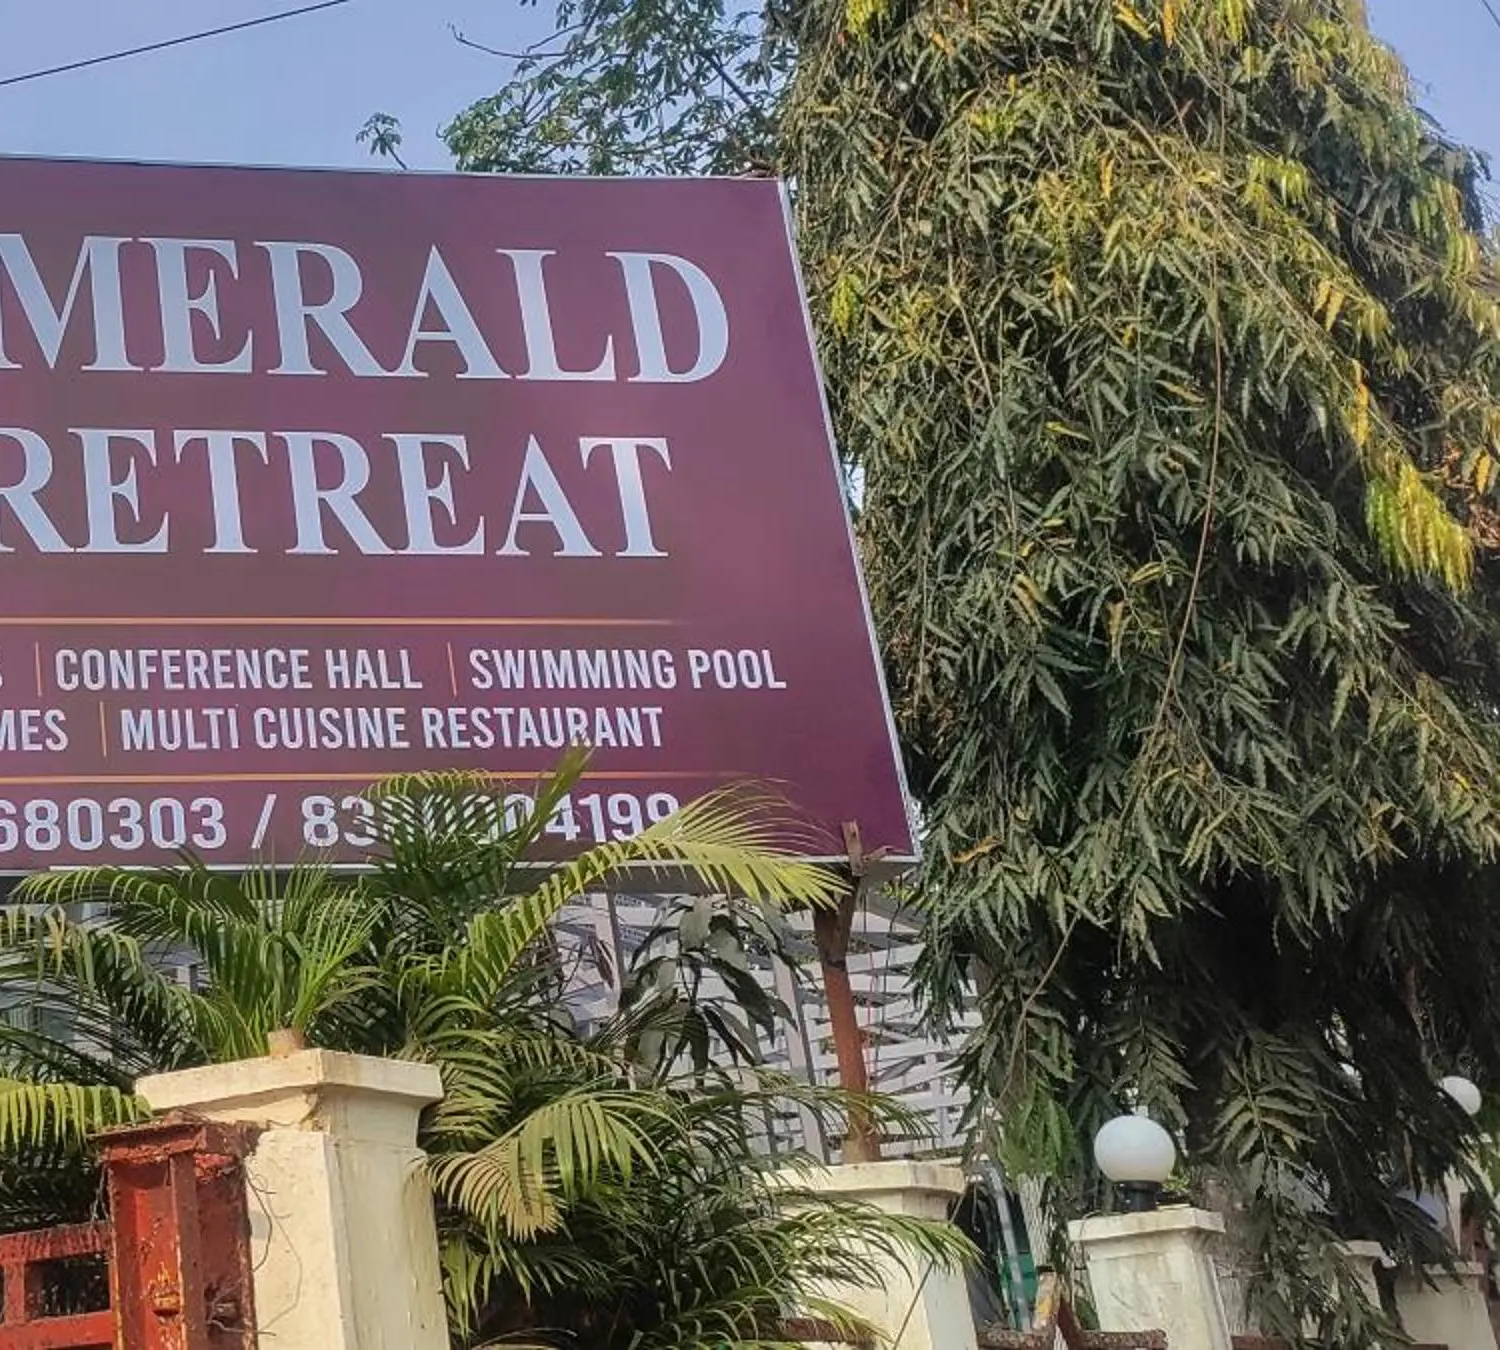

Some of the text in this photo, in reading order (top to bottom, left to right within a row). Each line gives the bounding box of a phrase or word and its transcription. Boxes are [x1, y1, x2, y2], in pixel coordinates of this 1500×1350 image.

[54, 648, 313, 691] CONFERENCE
[325, 648, 423, 690] HALL
[469, 648, 677, 689] SWIMMING
[687, 648, 787, 689] POOL
[120, 708, 240, 751] MULTI
[253, 706, 410, 750] CUISINE
[421, 706, 664, 749] RESTAURANT
[250, 793, 278, 849] /
